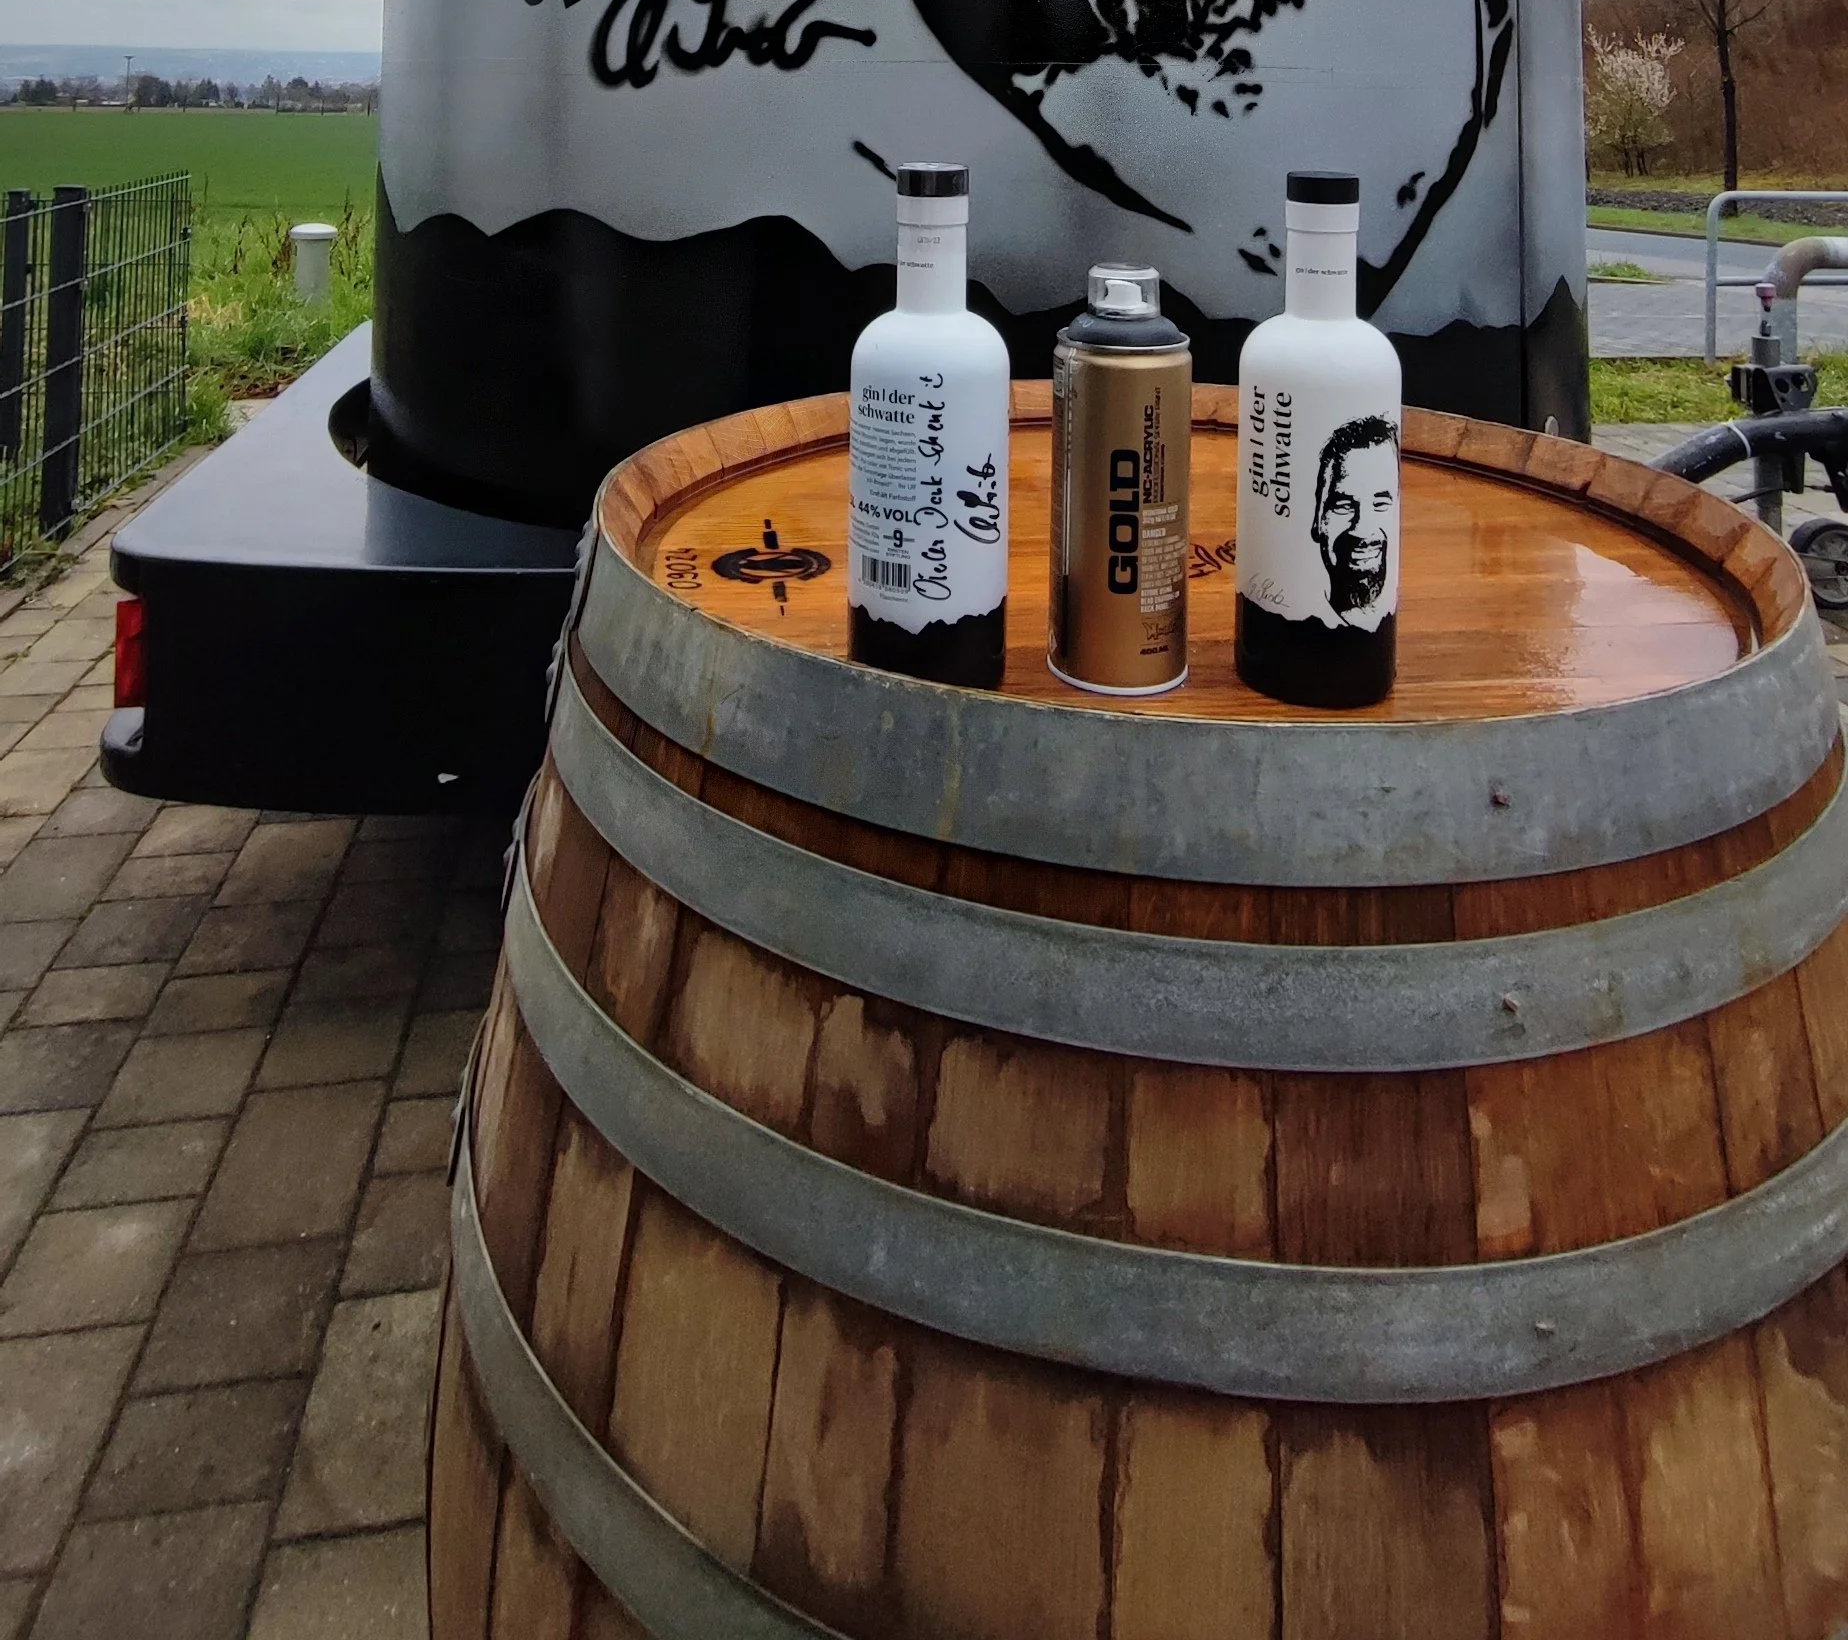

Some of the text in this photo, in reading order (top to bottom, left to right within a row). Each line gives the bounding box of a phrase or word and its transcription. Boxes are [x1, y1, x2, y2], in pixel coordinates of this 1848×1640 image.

[858, 403, 915, 425] schwatte
[862, 385, 880, 402] gin
[888, 389, 916, 405] der
[1249, 385, 1266, 433] der
[1143, 405, 1154, 504] NC-ACRYLIC
[1249, 452, 1269, 498] gin
[1270, 392, 1292, 518] schwatte
[858, 500, 881, 519] 44%
[1107, 448, 1140, 595] GOLD
